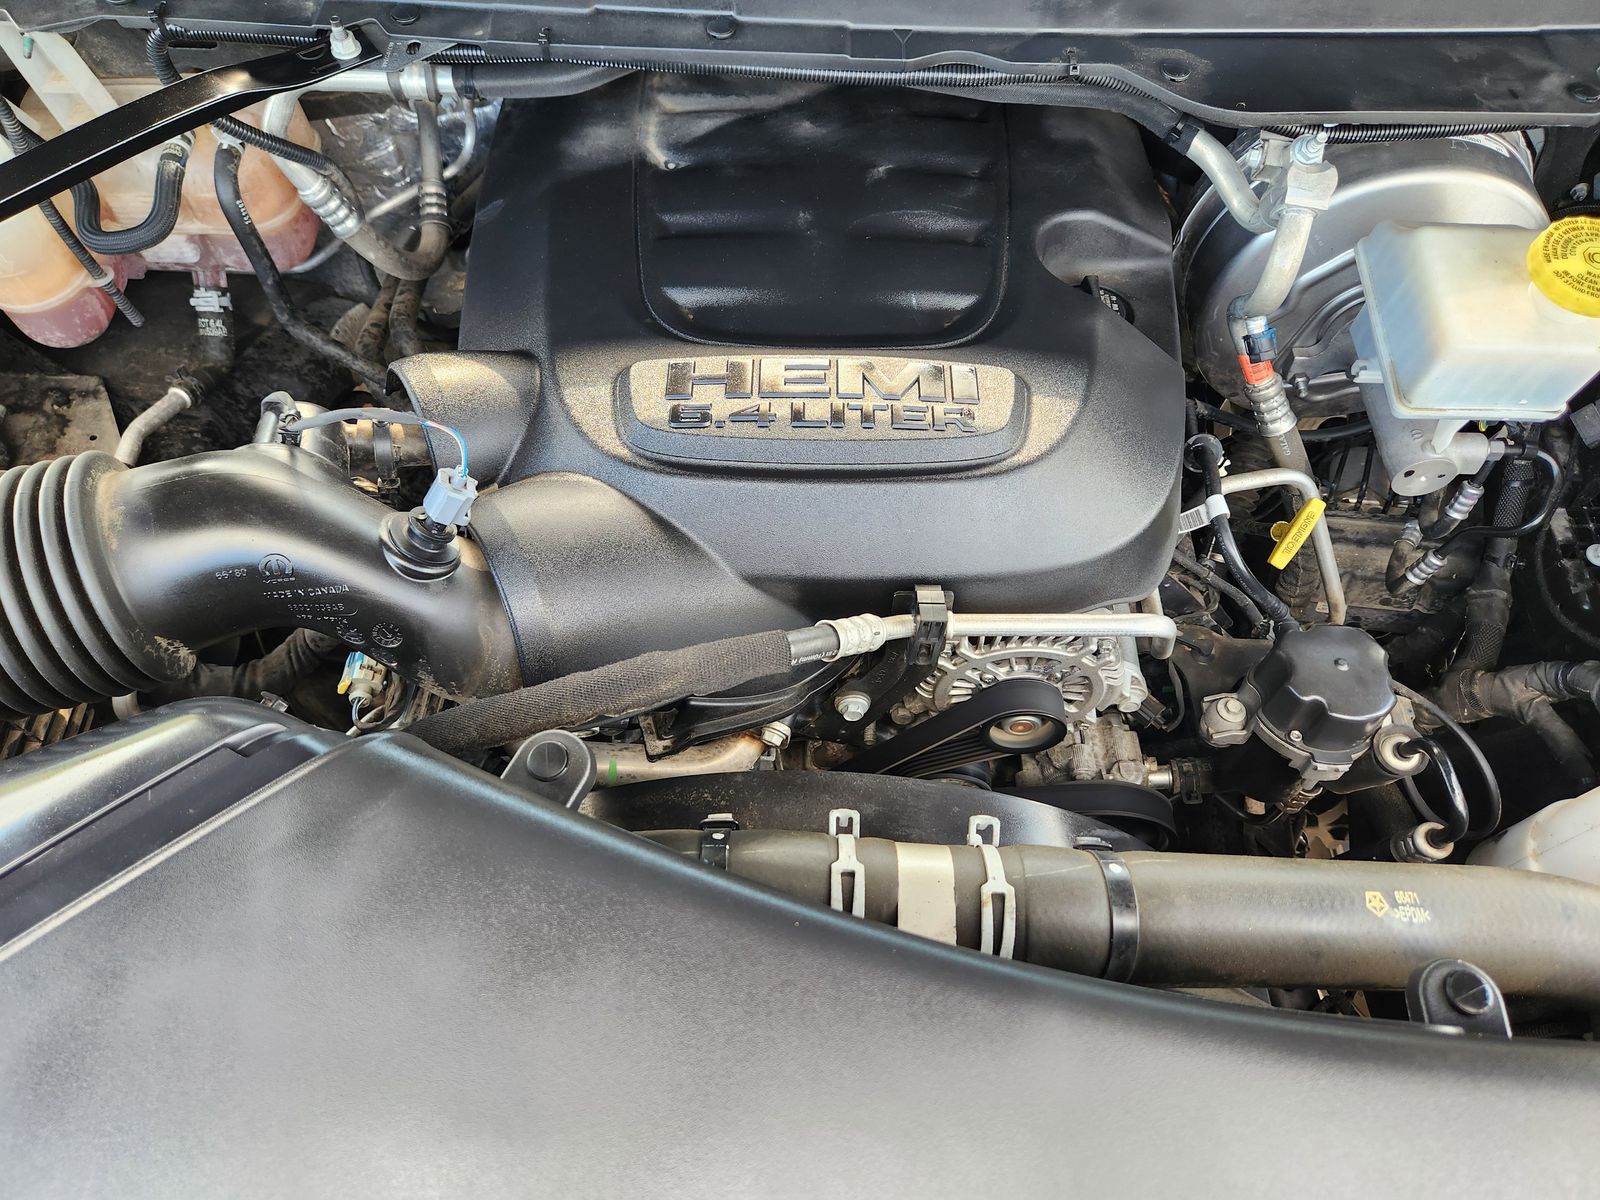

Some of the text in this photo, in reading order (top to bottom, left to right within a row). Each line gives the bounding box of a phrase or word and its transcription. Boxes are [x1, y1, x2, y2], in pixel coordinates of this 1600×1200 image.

[1561, 270, 1585, 286] BEFORE
[1577, 273, 1598, 286] CLEAN
[1568, 282, 1586, 294] FLUID
[664, 357, 981, 405] HEMI
[668, 401, 977, 433] 6.4 LITER
[1281, 510, 1316, 555] ENGINE OIL
[307, 584, 350, 597] CANADA
